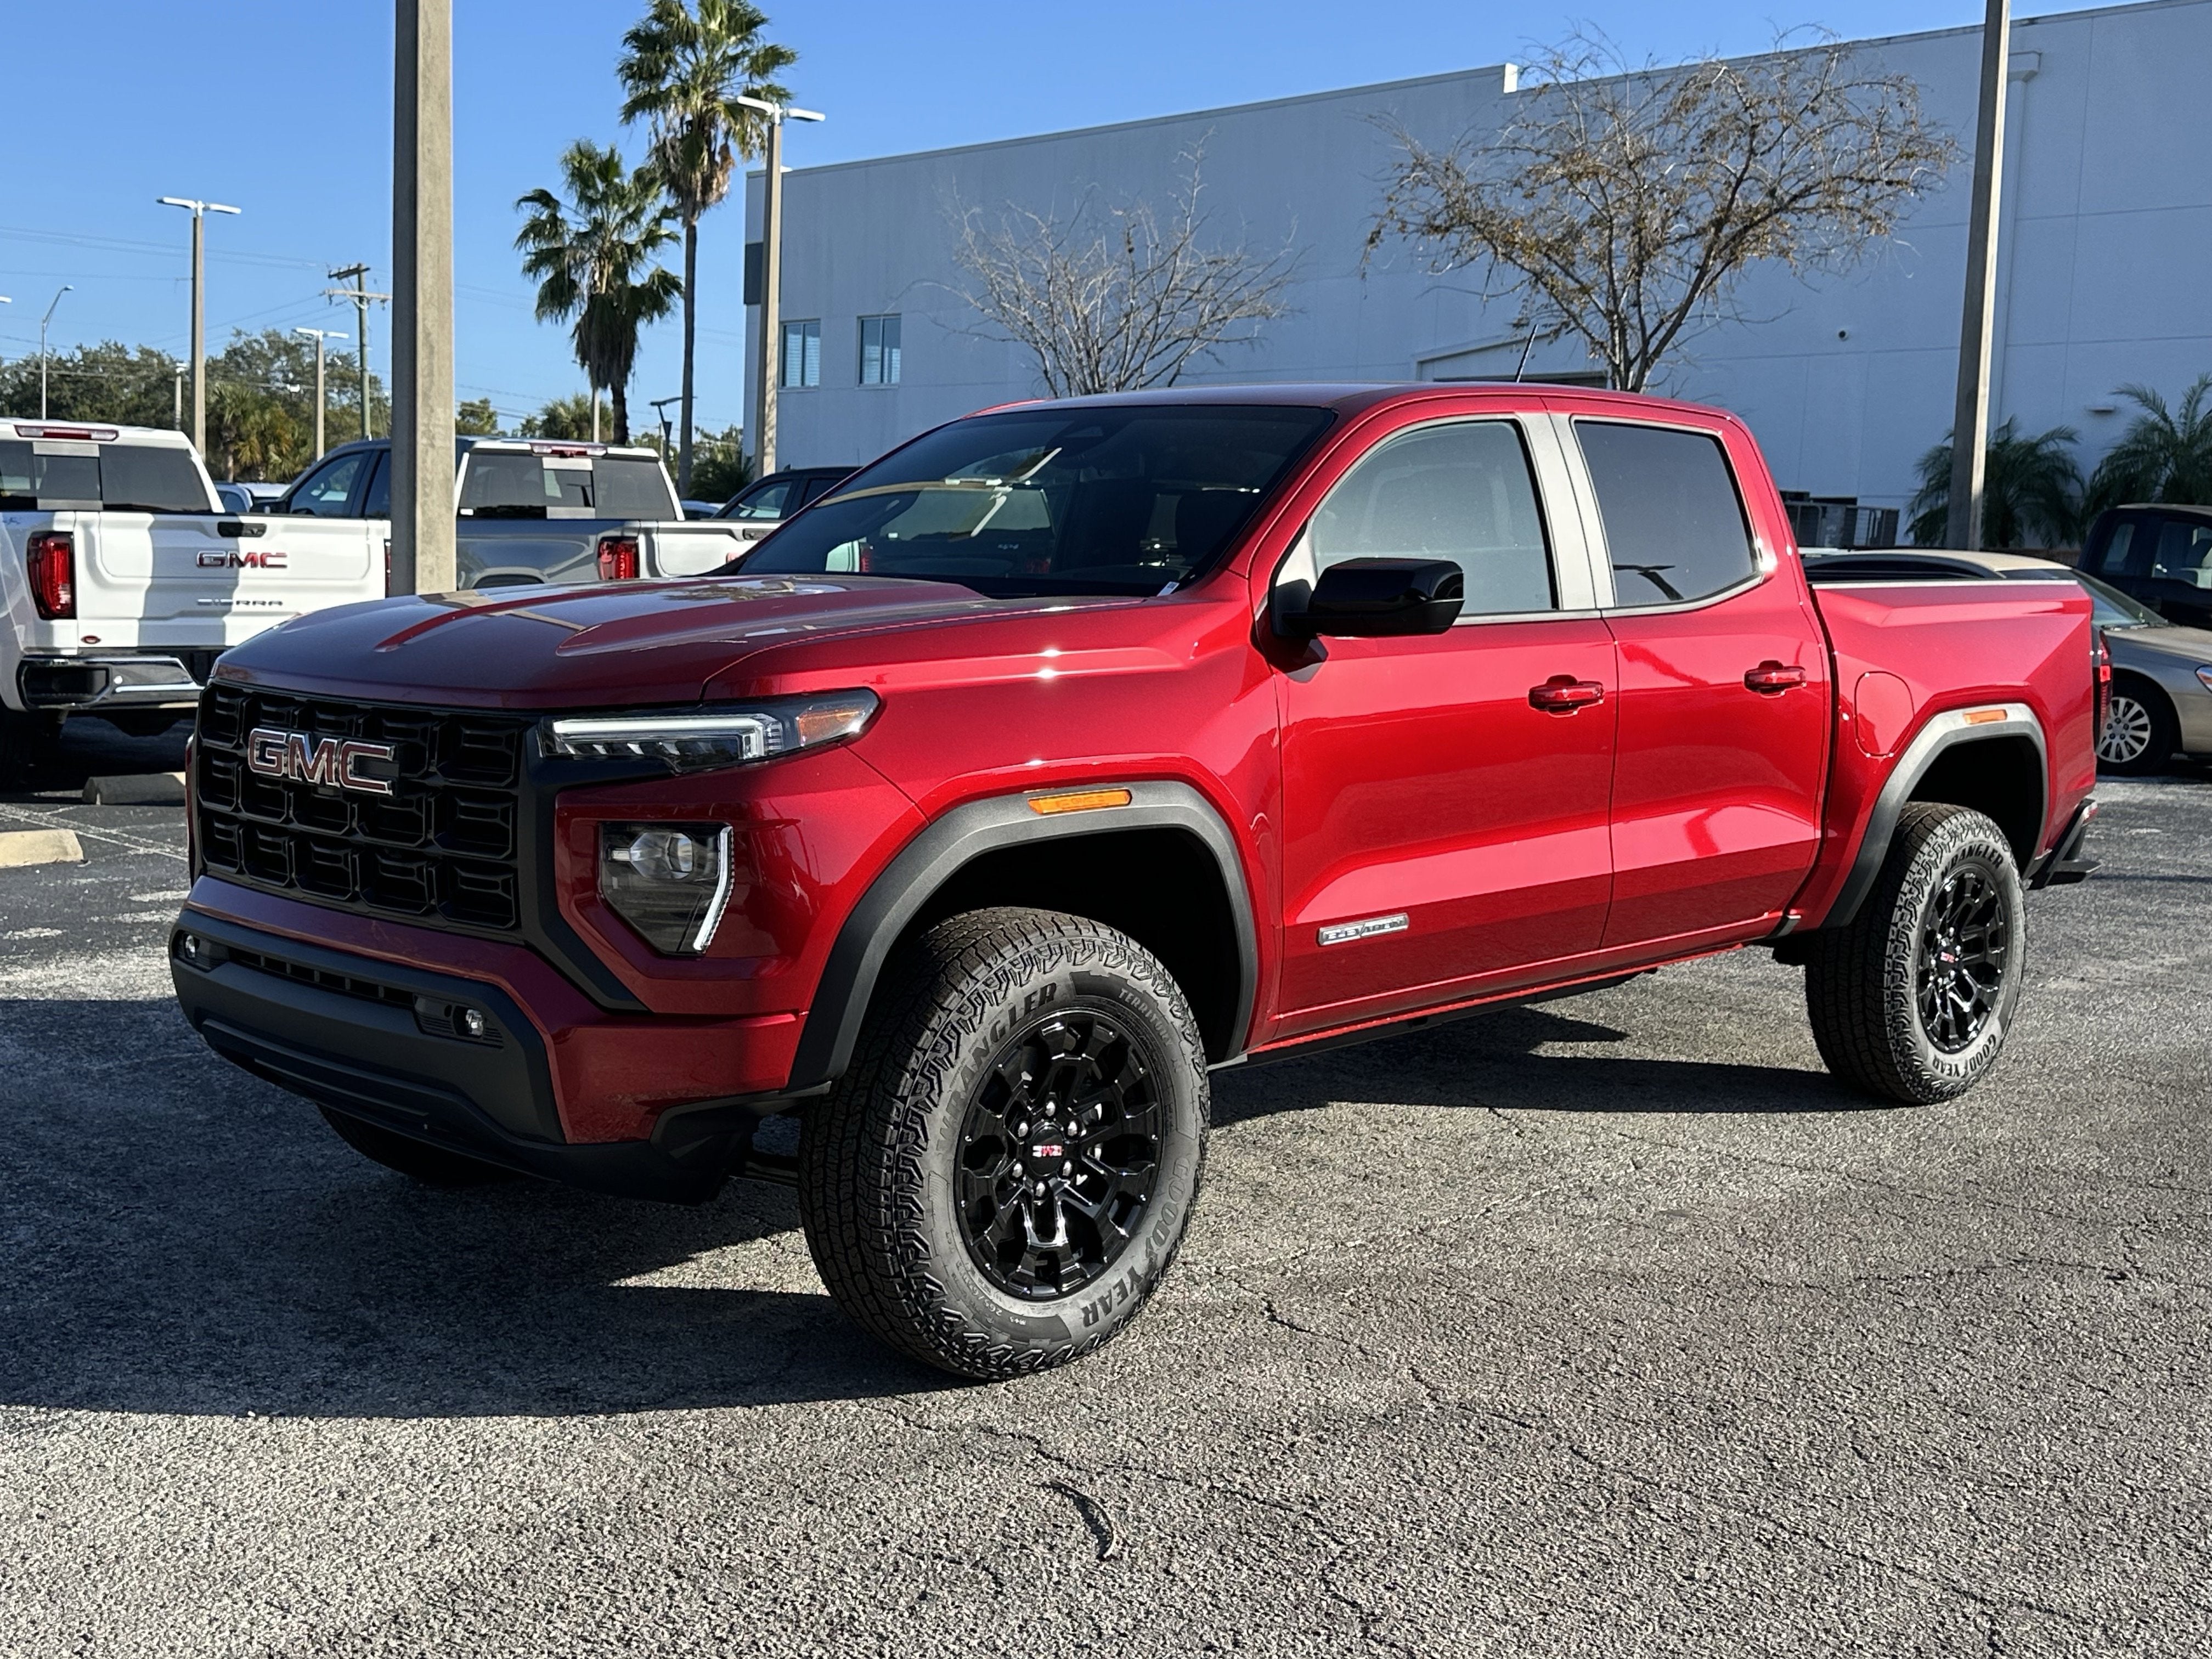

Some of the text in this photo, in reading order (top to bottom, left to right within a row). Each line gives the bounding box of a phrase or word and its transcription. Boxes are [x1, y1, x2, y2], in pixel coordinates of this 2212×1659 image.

[196, 551, 287, 569] GMC
[248, 728, 396, 795] GMC
[1119, 988, 1173, 1046] TERRITORY
[936, 982, 1057, 1152] WRANGLER
